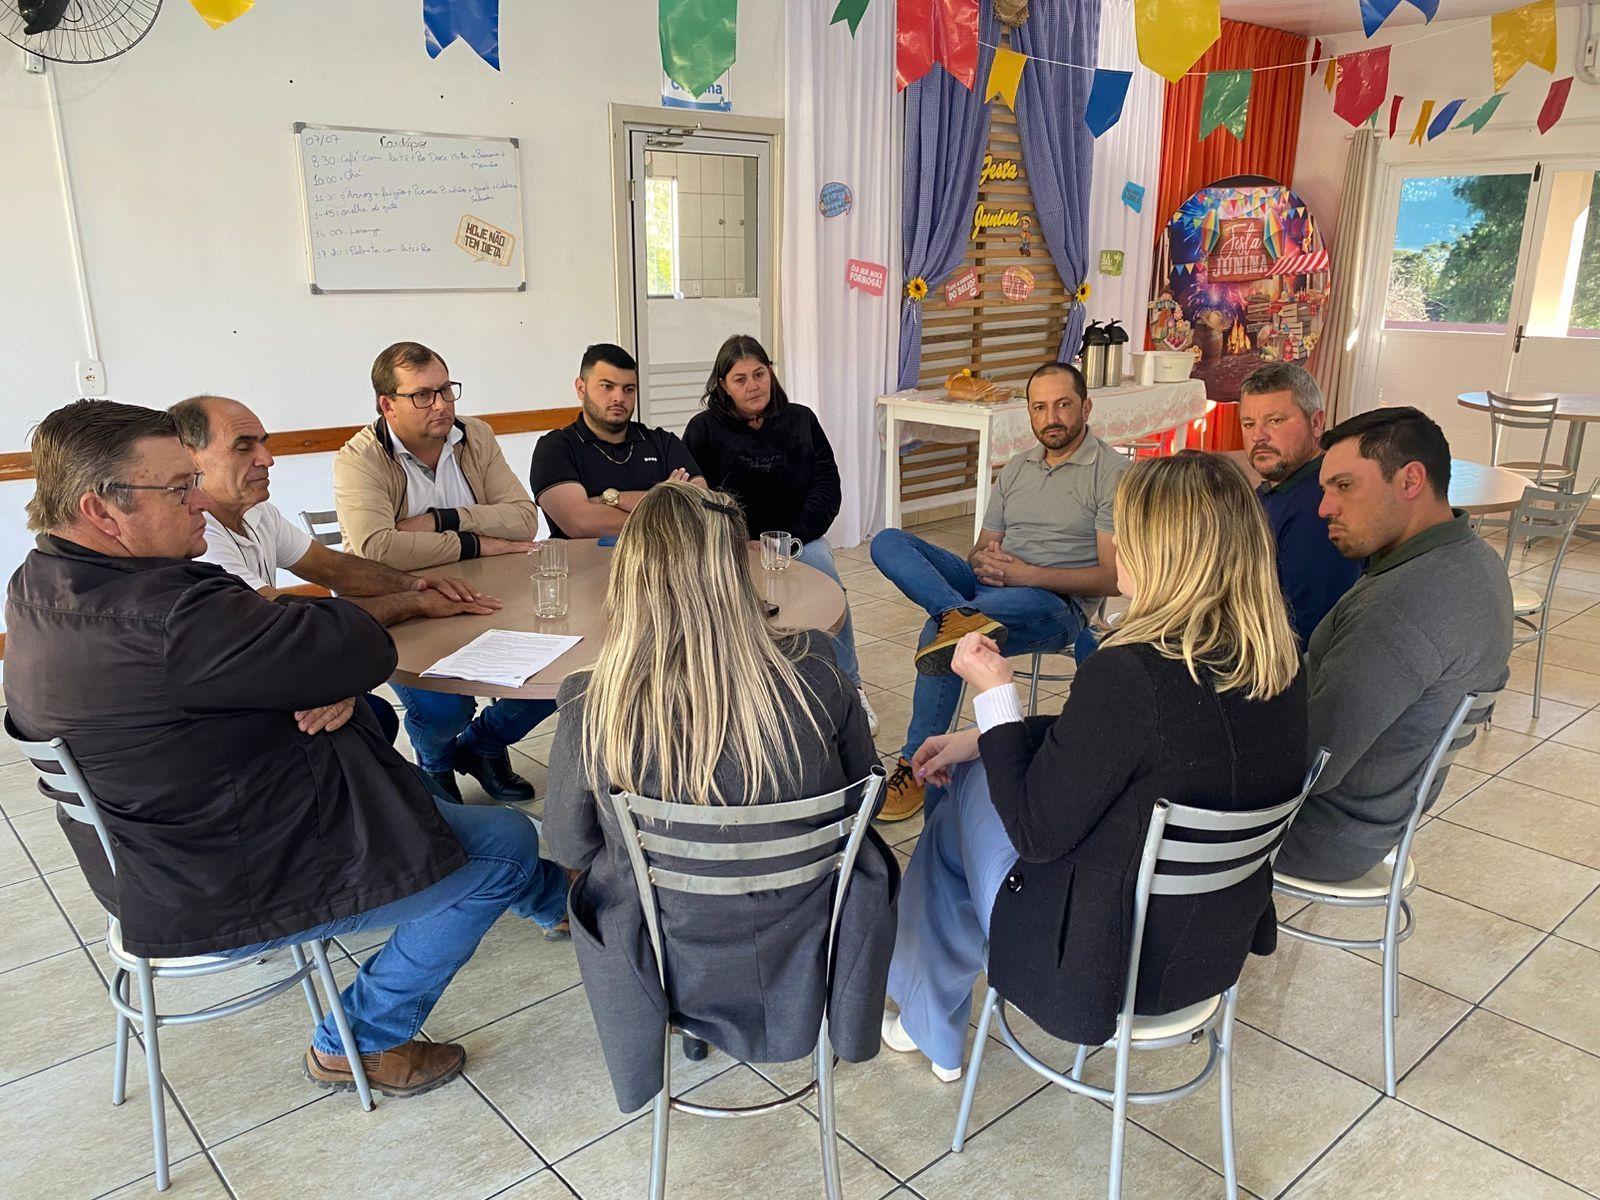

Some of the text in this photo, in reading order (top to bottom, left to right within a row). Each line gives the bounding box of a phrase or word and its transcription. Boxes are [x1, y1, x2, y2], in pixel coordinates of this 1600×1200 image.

[306, 134, 340, 147] 07/07
[362, 154, 381, 162] com
[978, 153, 1018, 187] Festa
[971, 203, 1019, 240] Junina
[466, 222, 505, 246] HOJE NÃO
[1220, 222, 1262, 260] Festa
[465, 235, 501, 259] TEM DIETA
[1212, 254, 1269, 277] JUNINA
